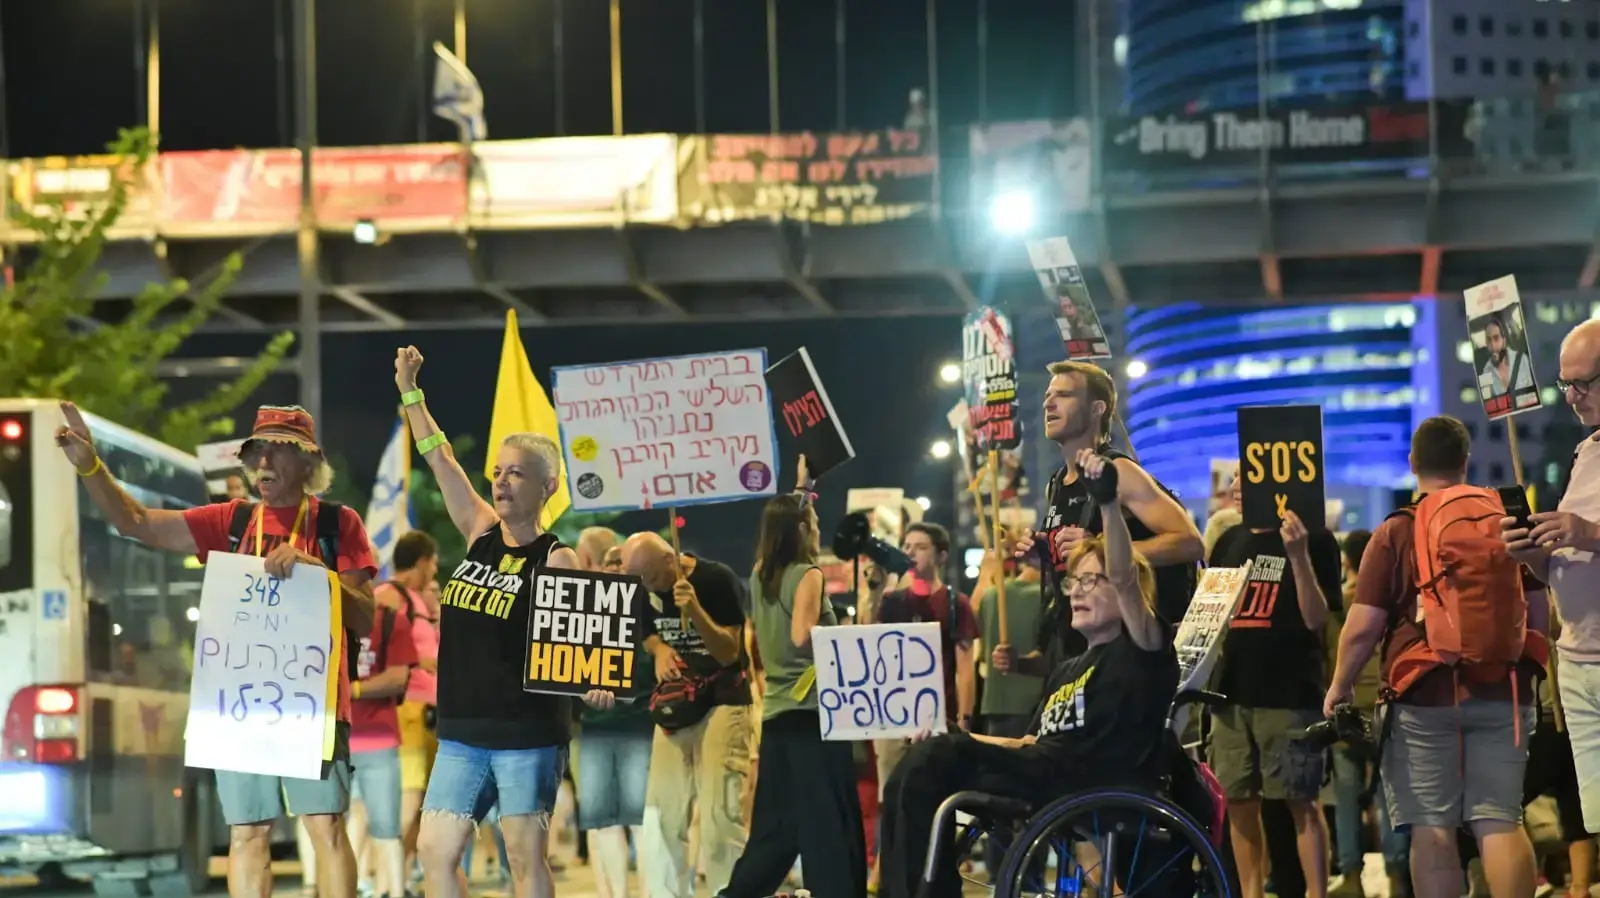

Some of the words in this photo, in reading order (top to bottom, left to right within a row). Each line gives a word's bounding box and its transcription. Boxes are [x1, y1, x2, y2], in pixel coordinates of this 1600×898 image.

[1140, 116, 1207, 159] Bring
[1213, 112, 1284, 149] Them
[1289, 109, 1364, 148] Home
[584, 361, 675, 393] המקדש
[685, 355, 756, 379] בבית
[615, 390, 670, 422] הכהן
[679, 378, 764, 408] השלישי
[632, 412, 714, 441] נתניהו
[783, 390, 827, 437] הצילו
[610, 442, 675, 479] קורבן
[688, 435, 759, 467] מקריב
[240, 573, 281, 607] 348
[484, 588, 516, 620] הם
[535, 575, 591, 611] GET
[594, 579, 638, 616] MY
[233, 611, 288, 632] ימים
[532, 609, 636, 649] PEOPLE
[529, 642, 634, 689] HOME!
[831, 630, 936, 688] כולנו
